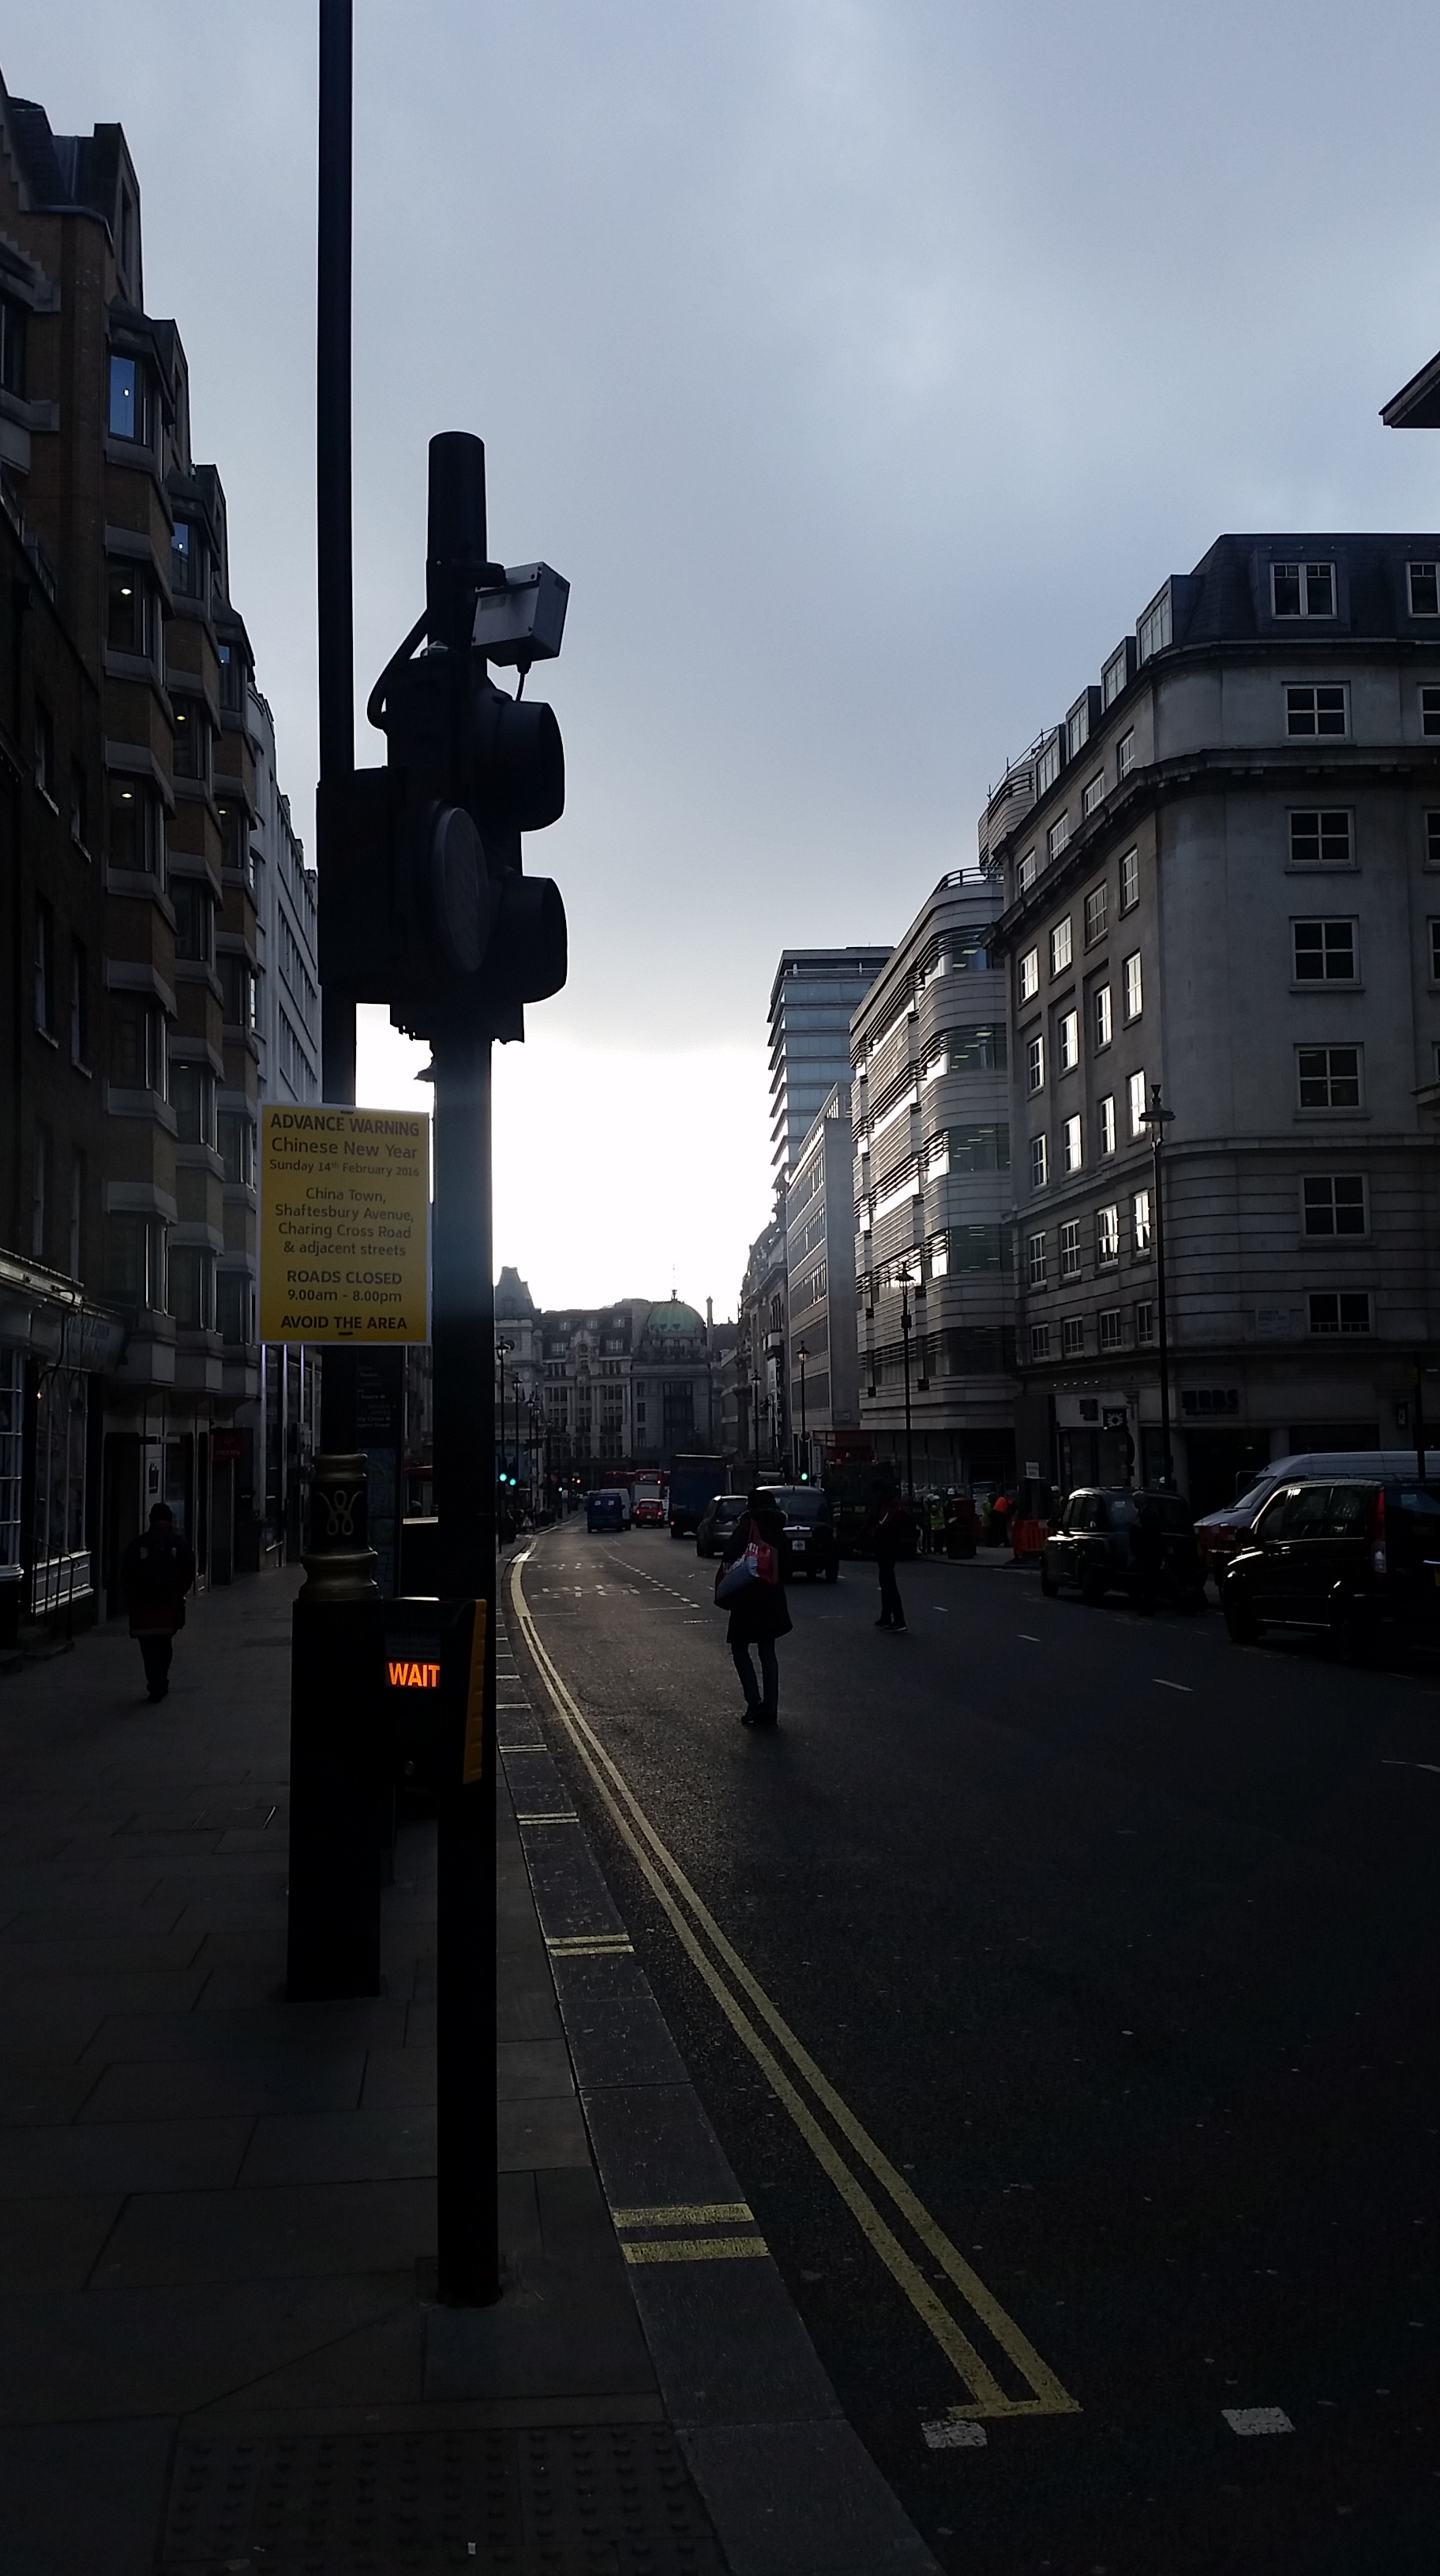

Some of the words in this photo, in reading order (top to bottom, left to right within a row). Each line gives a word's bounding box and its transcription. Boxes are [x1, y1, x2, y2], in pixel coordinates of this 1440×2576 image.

[270, 1114, 344, 1131] ADVANCE
[350, 1118, 420, 1136] WARNING
[272, 1137, 338, 1154] Chinese
[343, 1142, 379, 1157] New
[385, 1144, 417, 1159] Year
[269, 1159, 314, 1173] Sunday
[317, 1161, 339, 1172] 14th
[343, 1163, 392, 1177] February
[396, 1166, 419, 1177] 2016
[306, 1188, 343, 1200] China
[348, 1189, 386, 1204] Town,
[275, 1204, 358, 1220] Shaftesbury
[363, 1208, 414, 1222] Avenue,
[278, 1222, 332, 1238] Charing
[336, 1225, 374, 1237] Cross
[378, 1226, 411, 1238] Road
[283, 1241, 294, 1253] &
[299, 1241, 356, 1256] adjacent
[361, 1245, 406, 1256] streets
[287, 1270, 341, 1282] ROADS
[346, 1272, 402, 1285] CLOSED
[287, 1289, 337, 1301] 9.00am
[353, 1290, 402, 1305] 8.00pm
[281, 1316, 328, 1328] AVOID
[334, 1316, 362, 1328] THE
[367, 1317, 407, 1329] AREA
[1198, 1390, 1239, 1408] RBS
[388, 1662, 440, 1687] WAIT
